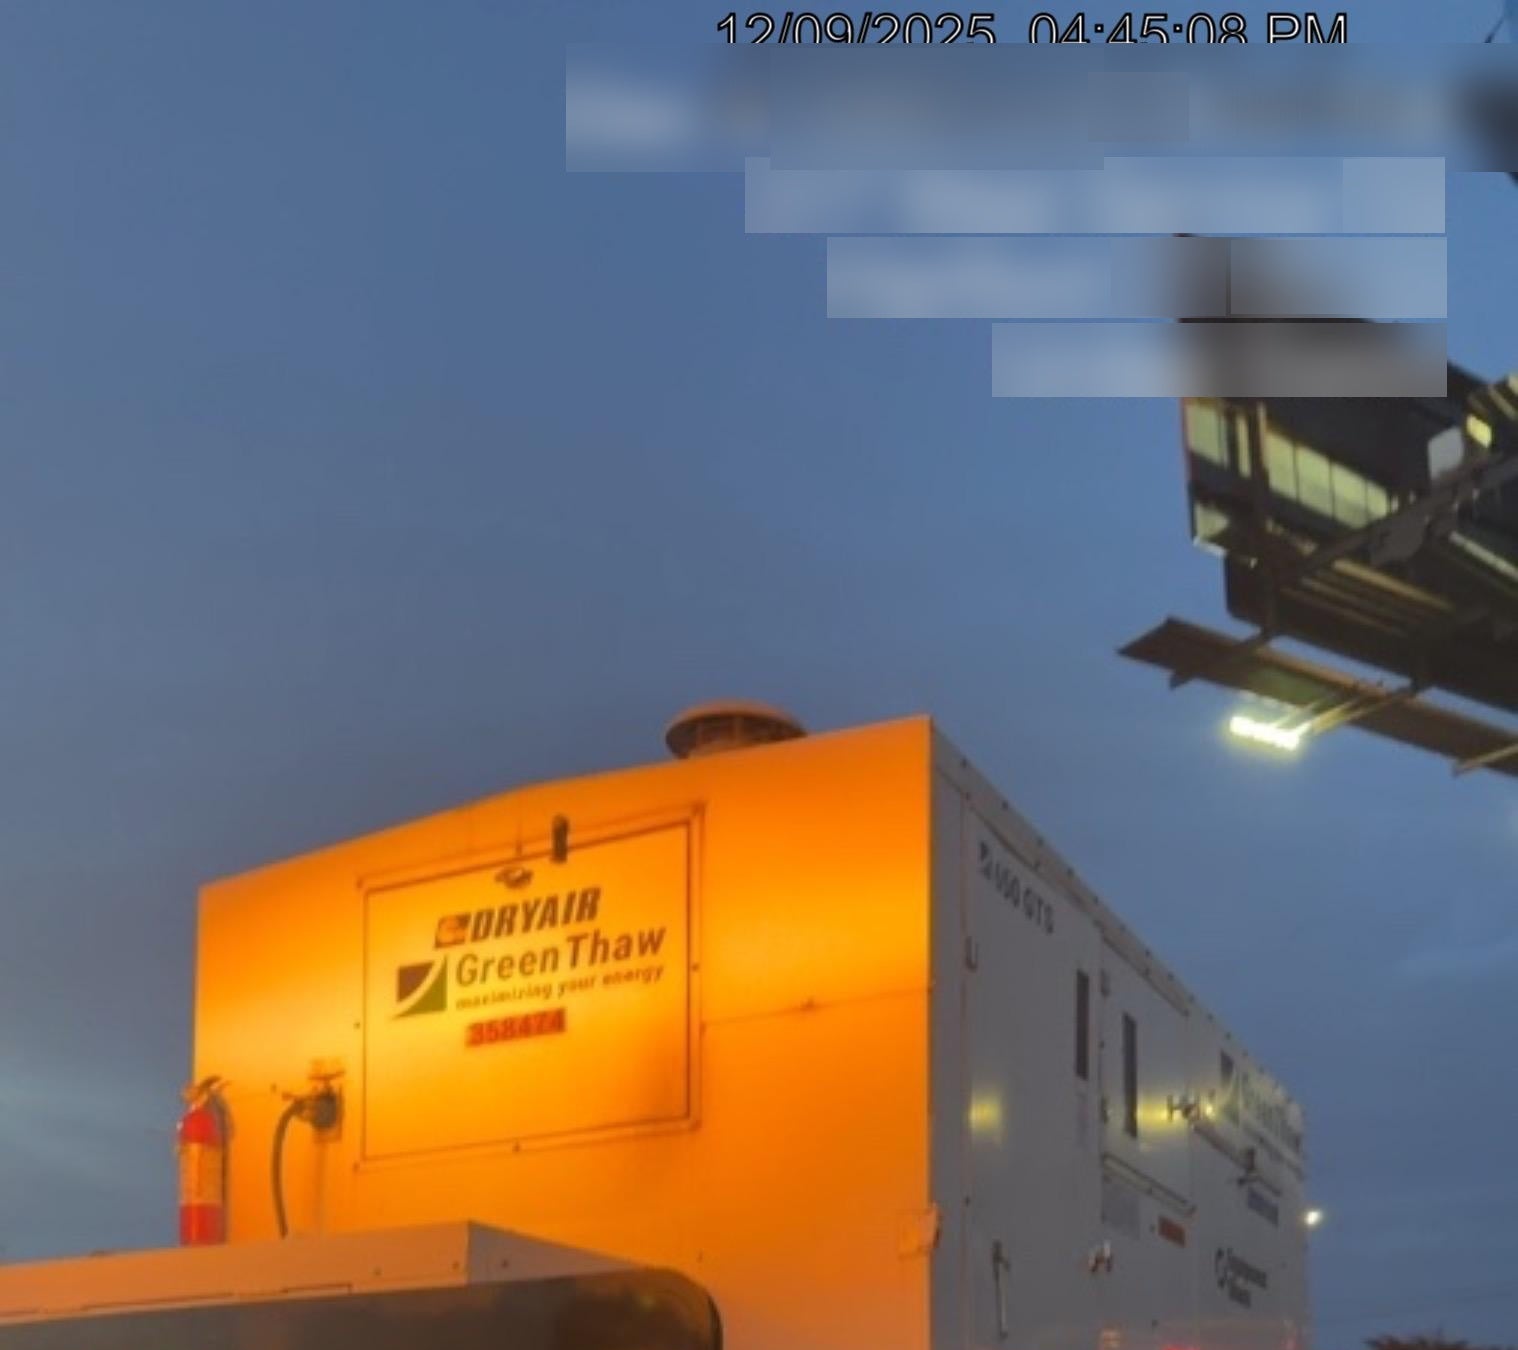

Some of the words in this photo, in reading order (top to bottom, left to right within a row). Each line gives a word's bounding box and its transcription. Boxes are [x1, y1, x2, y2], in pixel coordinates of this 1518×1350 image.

[471, 887, 601, 943] DRYAIR
[558, 975, 596, 999] your
[602, 965, 664, 986] energy
